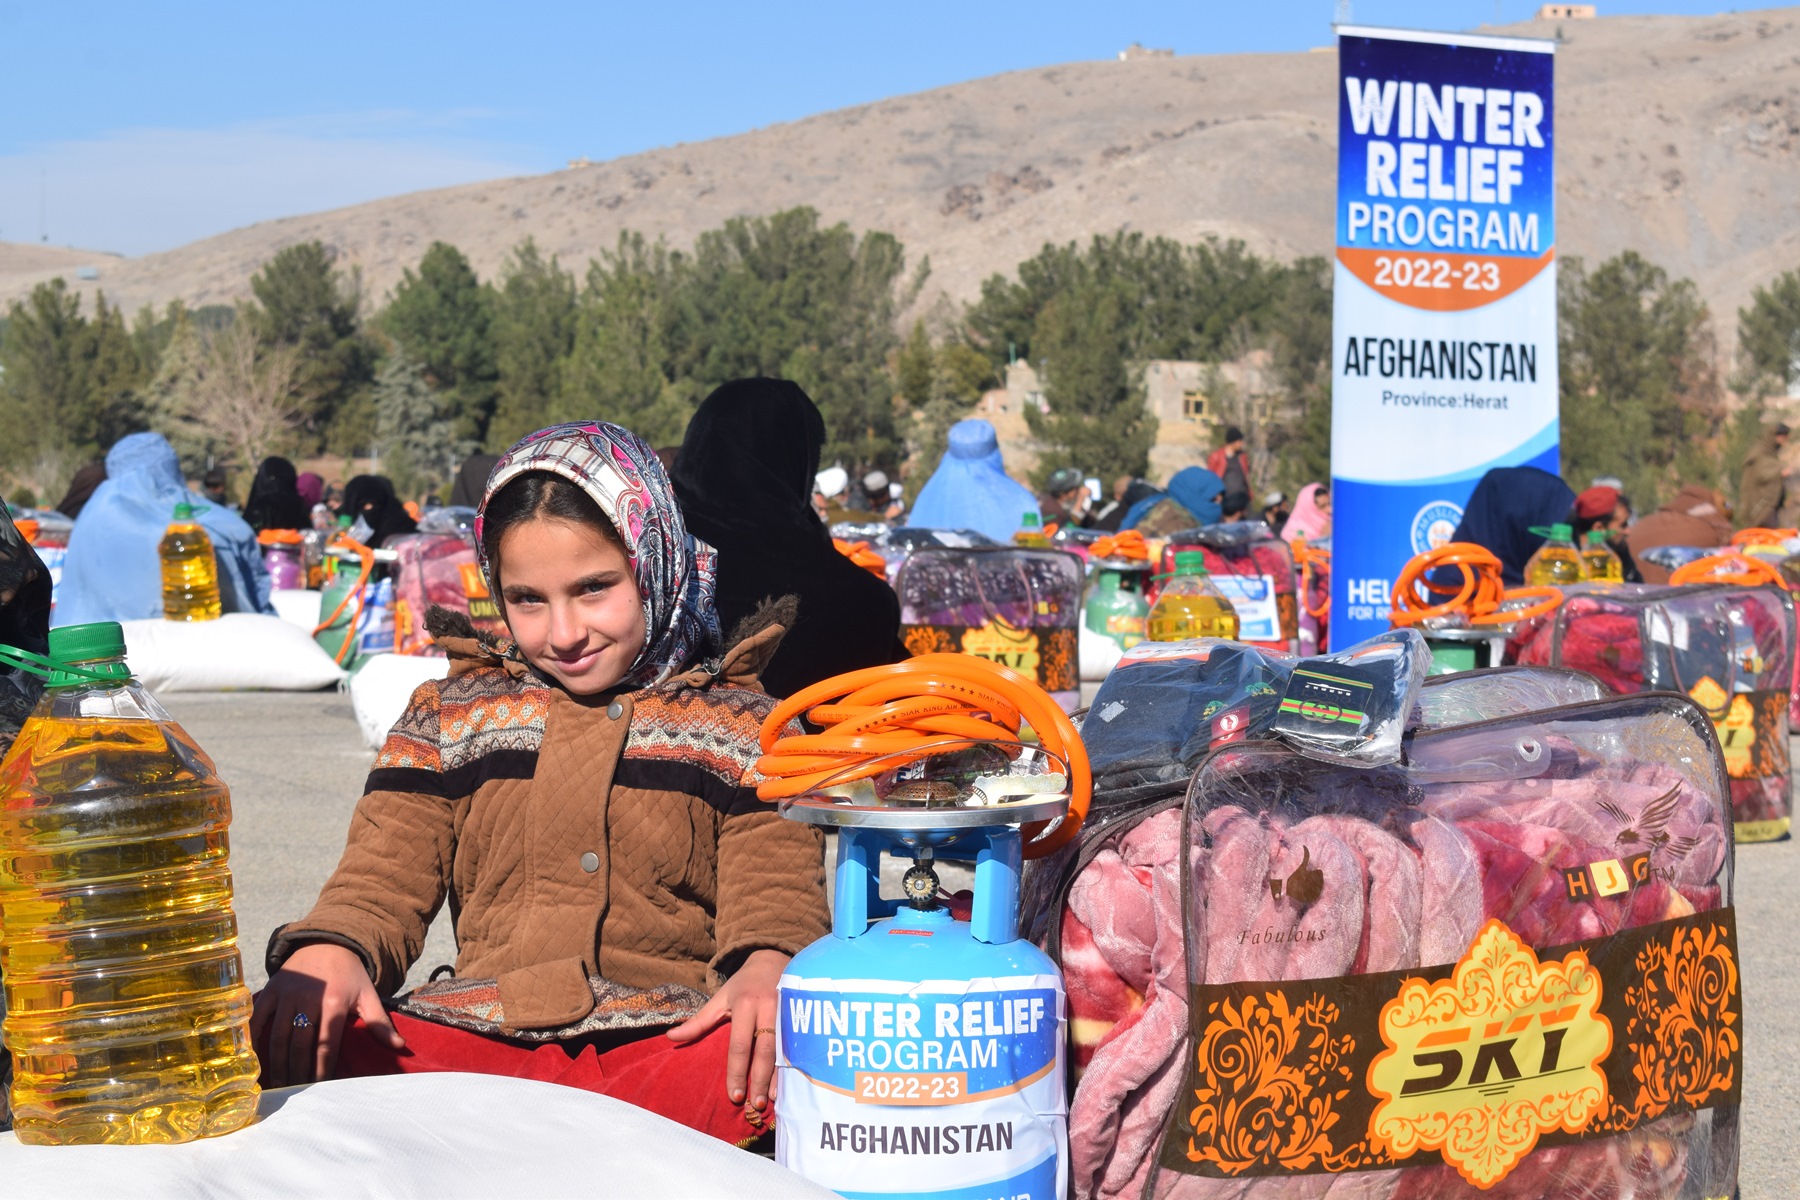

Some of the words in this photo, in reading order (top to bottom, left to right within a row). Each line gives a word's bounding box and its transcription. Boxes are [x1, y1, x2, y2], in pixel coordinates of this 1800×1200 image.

[1345, 76, 1545, 148] WINTER
[1366, 140, 1524, 204] RELIEF
[1347, 201, 1539, 252] PROGRAM
[1374, 256, 1501, 291] 2022-23
[1343, 337, 1537, 382] AFGHANISTAN
[1382, 390, 1509, 410] Province:Herat
[1236, 924, 1327, 945] Fabulous
[789, 997, 921, 1038] WINTER
[935, 997, 1045, 1038] RELIEF
[827, 1038, 998, 1071] PROGRAM
[1400, 1003, 1581, 1095] SKY
[862, 1076, 960, 1099] 2022-23
[820, 1121, 1014, 1155] AFGHANISTAN
